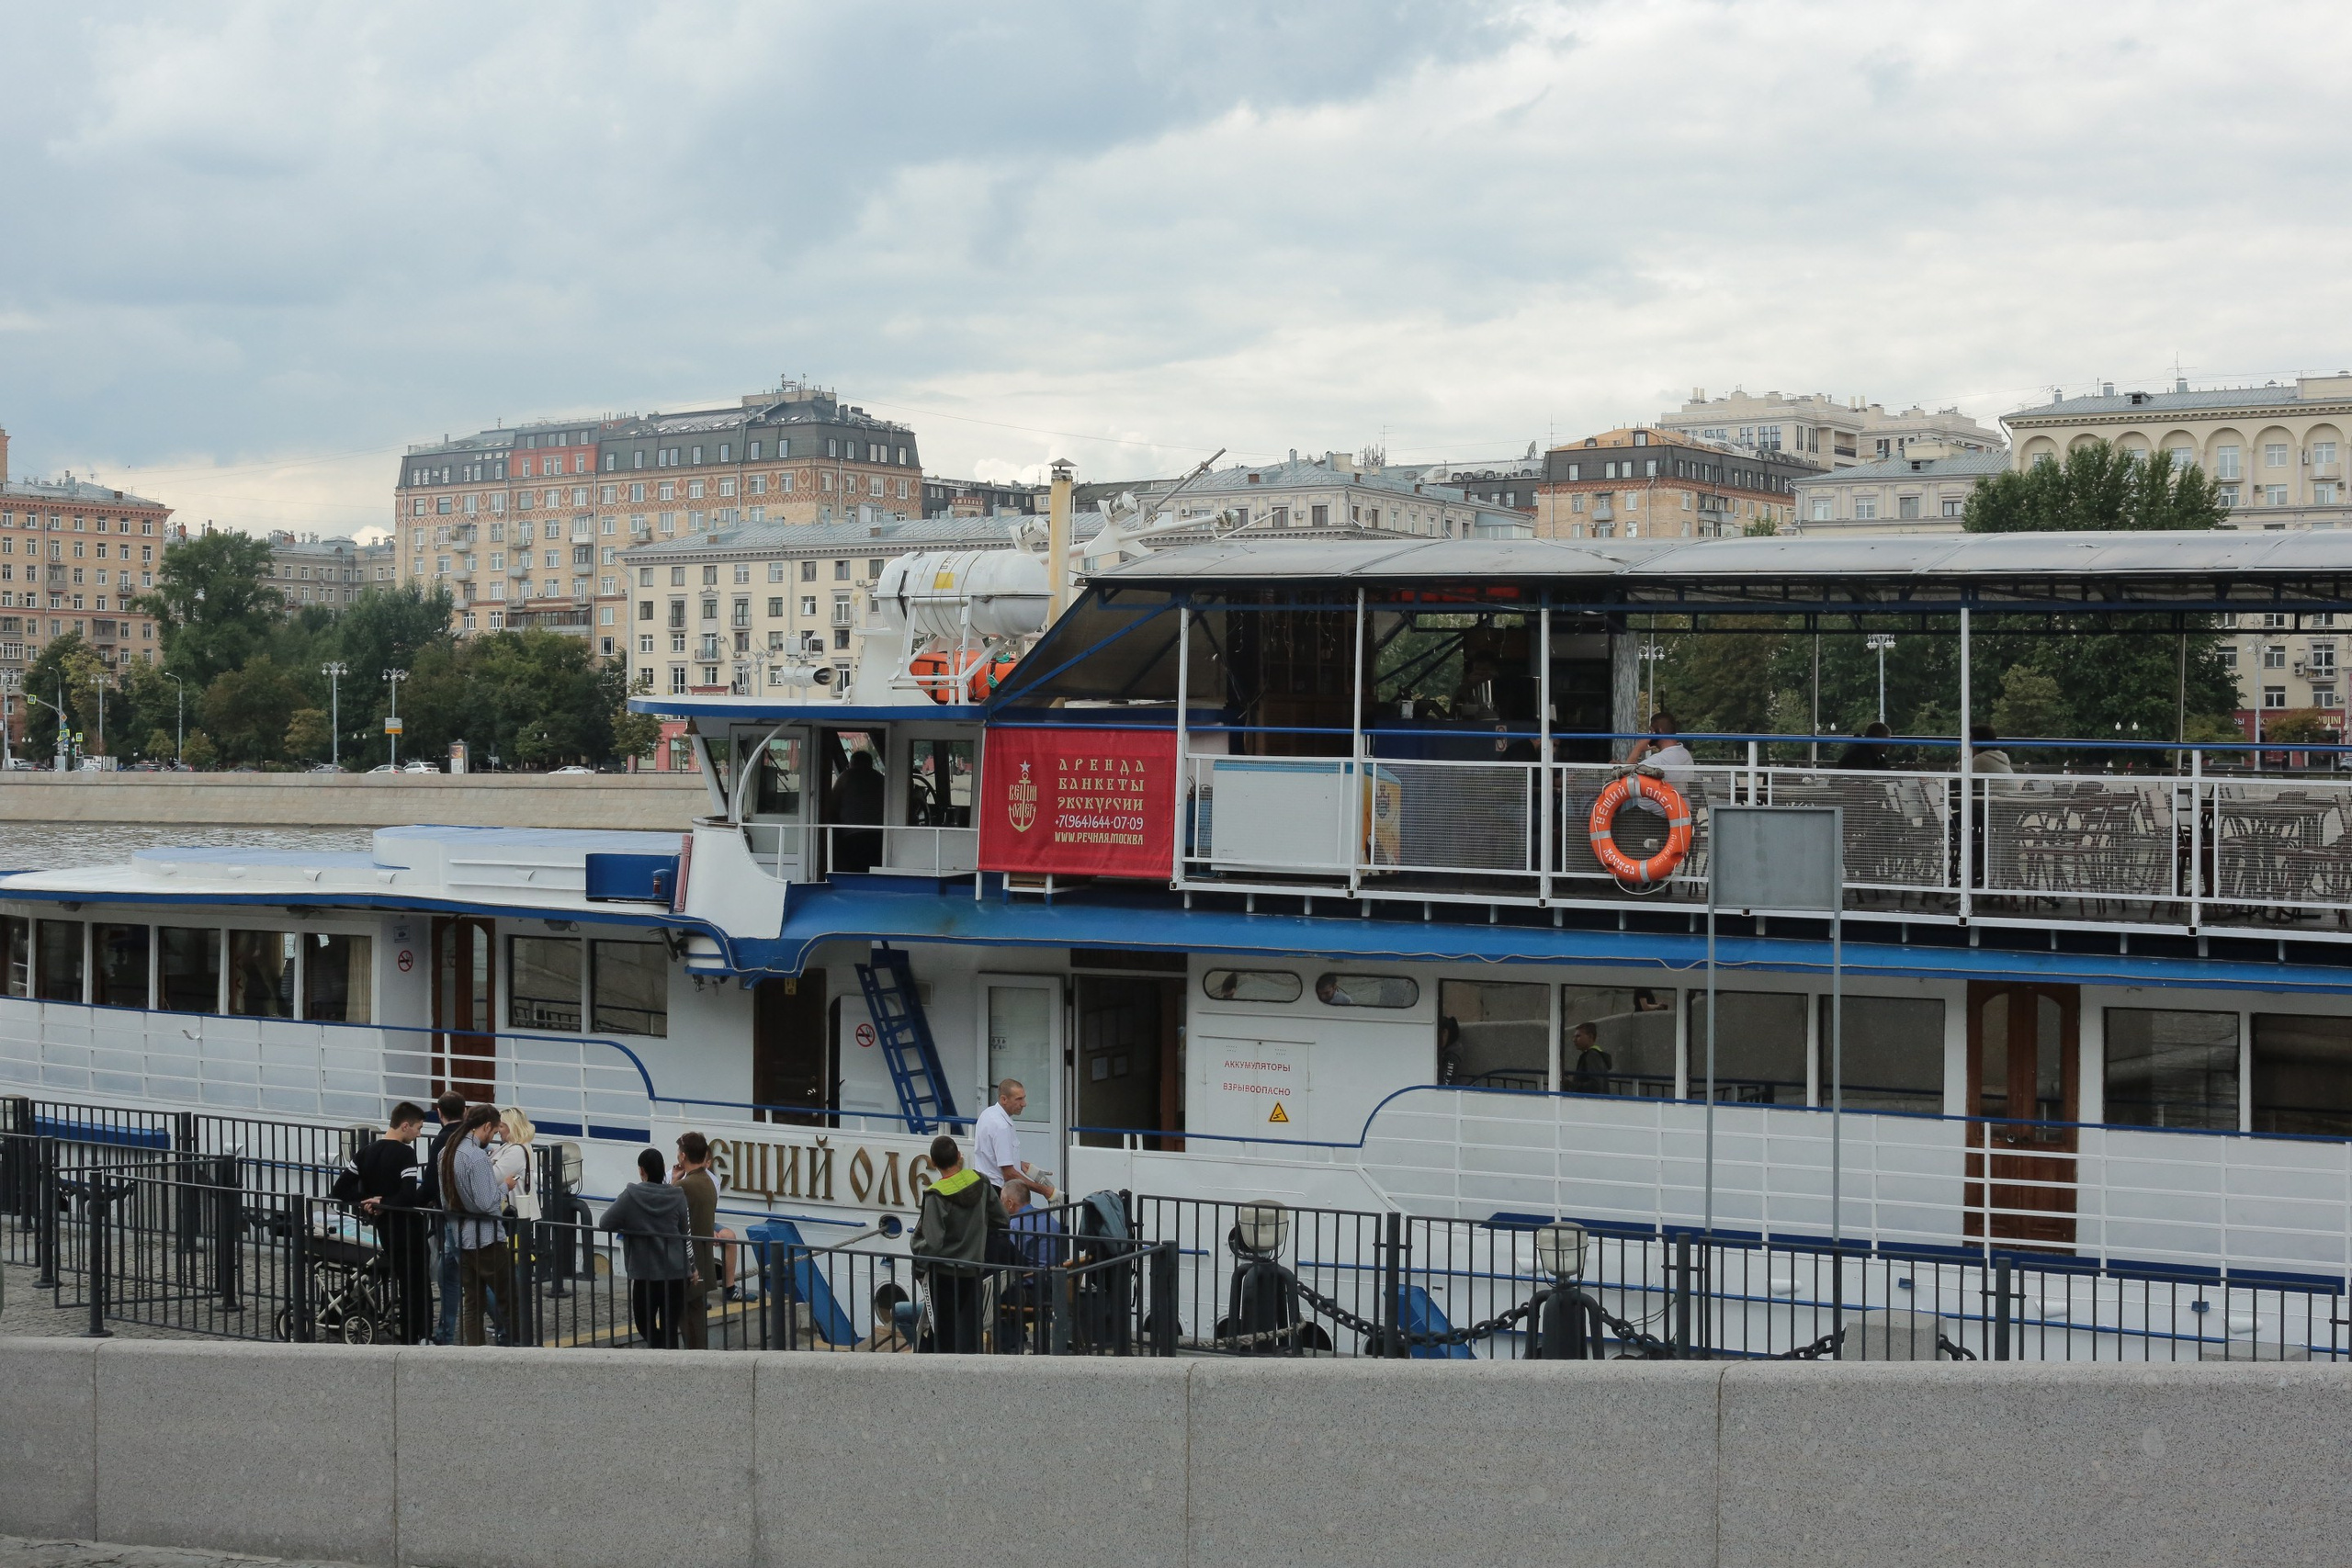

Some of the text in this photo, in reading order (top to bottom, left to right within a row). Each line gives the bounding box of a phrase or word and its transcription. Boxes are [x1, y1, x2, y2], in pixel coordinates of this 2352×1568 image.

[1058, 759, 1145, 775] АРЕНДА
[1058, 778, 1144, 791] БАНКЕТЫ
[1057, 796, 1144, 813] ЭКСКУРСИИ
[1595, 785, 1673, 825] ВЕЩИЙ ОЛЕГ
[1224, 1060, 1291, 1072] АККУМУЛЯТОРЫ
[1223, 1082, 1291, 1096] ВЗРЫВООПАСНО
[708, 1135, 936, 1212] ЕЩИЙ ОЛЕ
